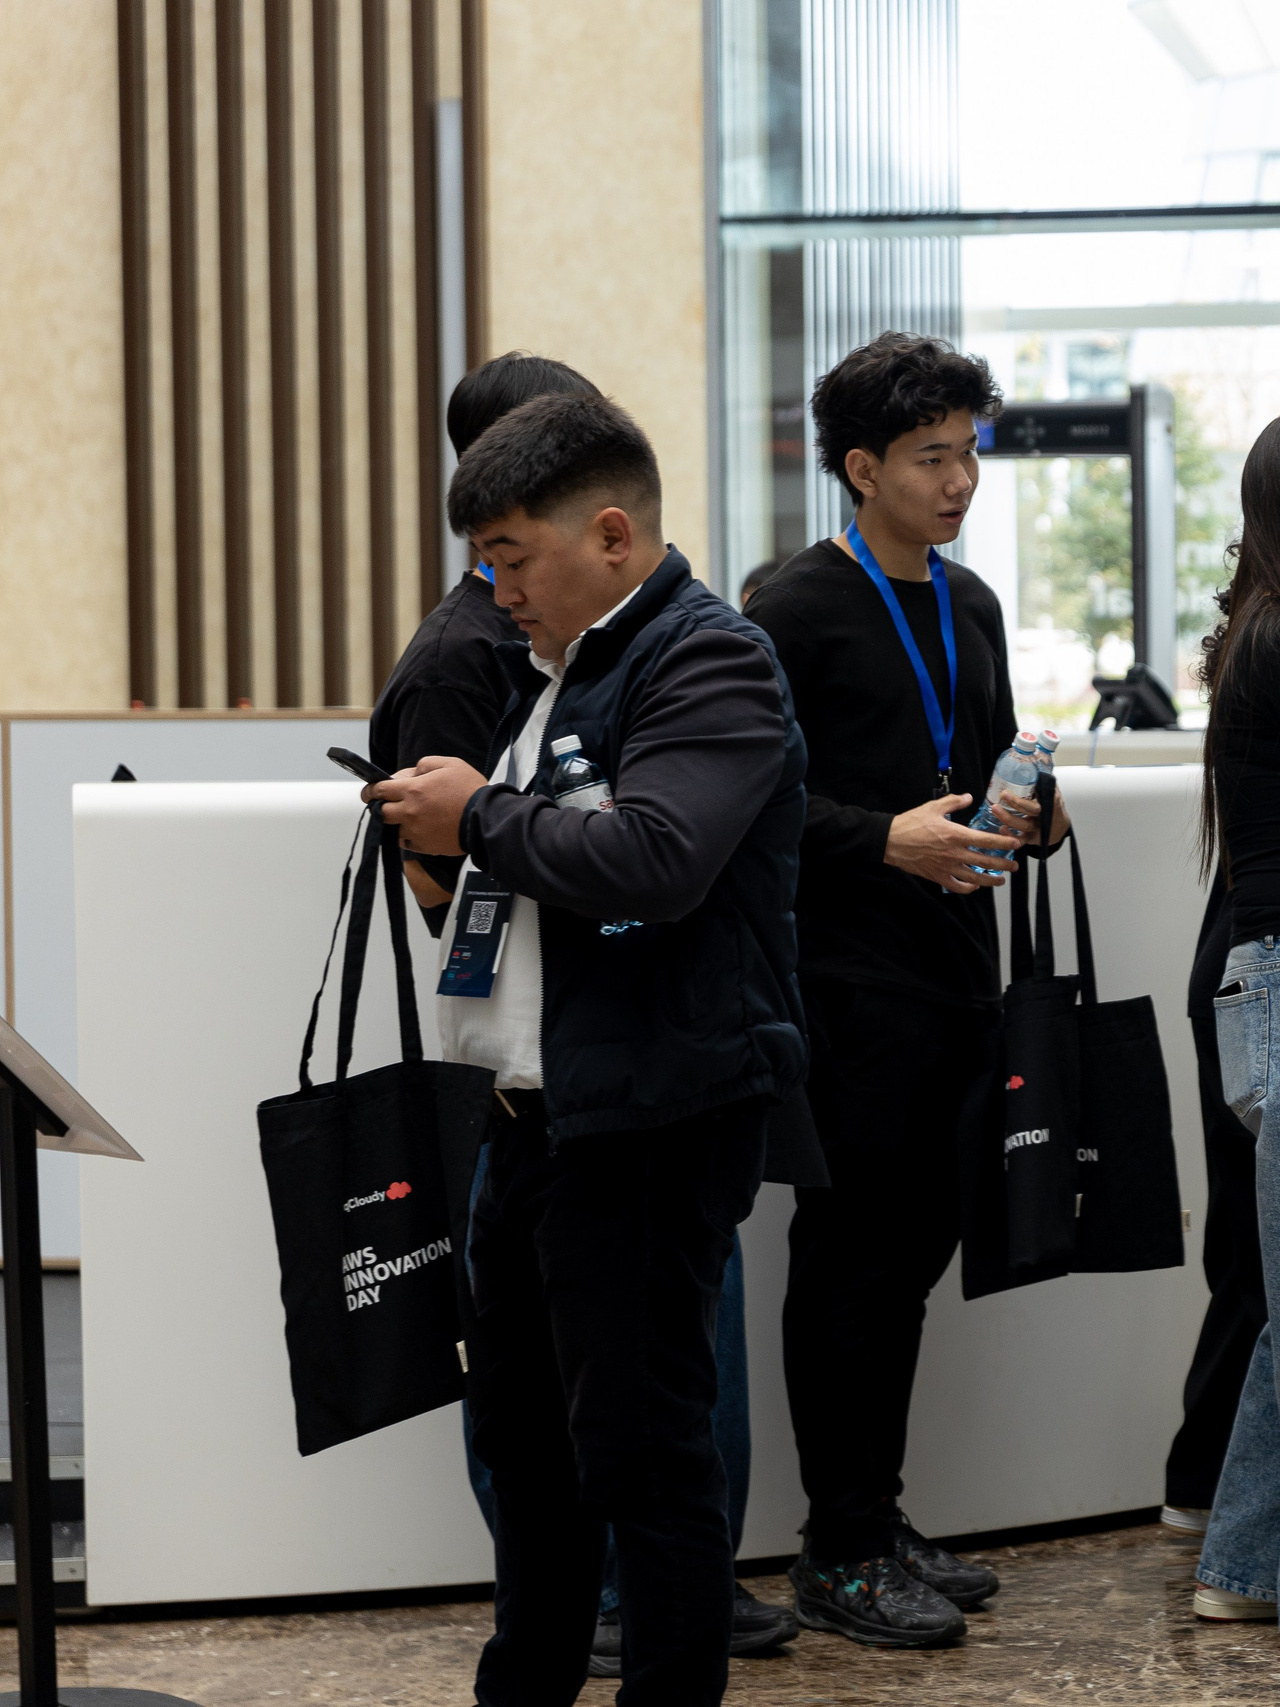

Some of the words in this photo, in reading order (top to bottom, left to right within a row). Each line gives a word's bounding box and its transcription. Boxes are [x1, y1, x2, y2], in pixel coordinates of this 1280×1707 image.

[342, 1246, 378, 1274] AWS
[343, 1236, 453, 1293] INNOVATION
[345, 1285, 381, 1312] DAY
